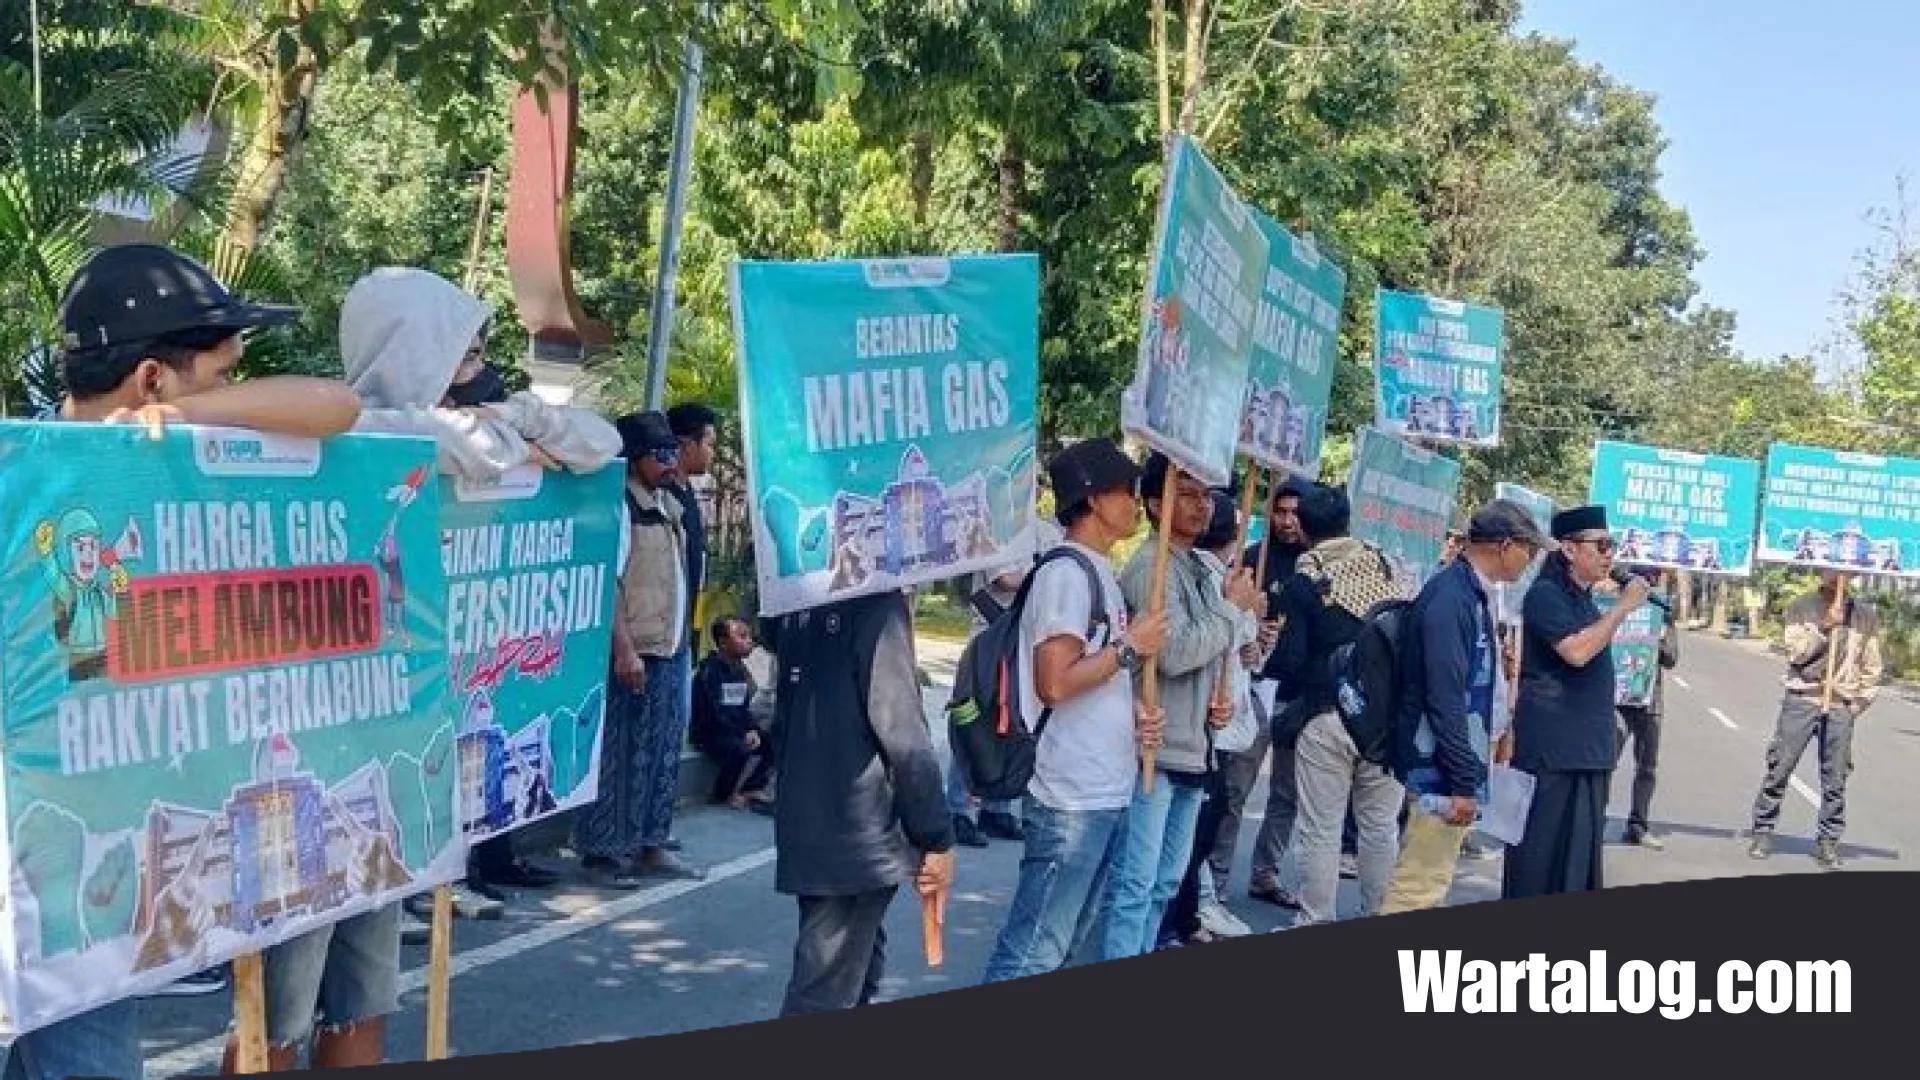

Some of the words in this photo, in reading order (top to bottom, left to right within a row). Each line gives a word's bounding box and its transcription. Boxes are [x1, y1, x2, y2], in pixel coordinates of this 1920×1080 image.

[857, 313, 958, 358] BERANTAS
[803, 366, 931, 453] MAFIA
[941, 359, 1009, 433] GAS
[1624, 477, 1682, 504] MAFIA
[1689, 484, 1724, 510] GAS
[154, 500, 275, 573] HARGA
[286, 500, 349, 563] GAS
[441, 524, 504, 576] IKAN
[509, 517, 574, 568] HARGA
[116, 574, 374, 677] MELAMBUNG
[449, 562, 606, 654] ERSUBSIDI
[58, 679, 210, 775] RAKYAT
[225, 653, 410, 745] BERKABUNG
